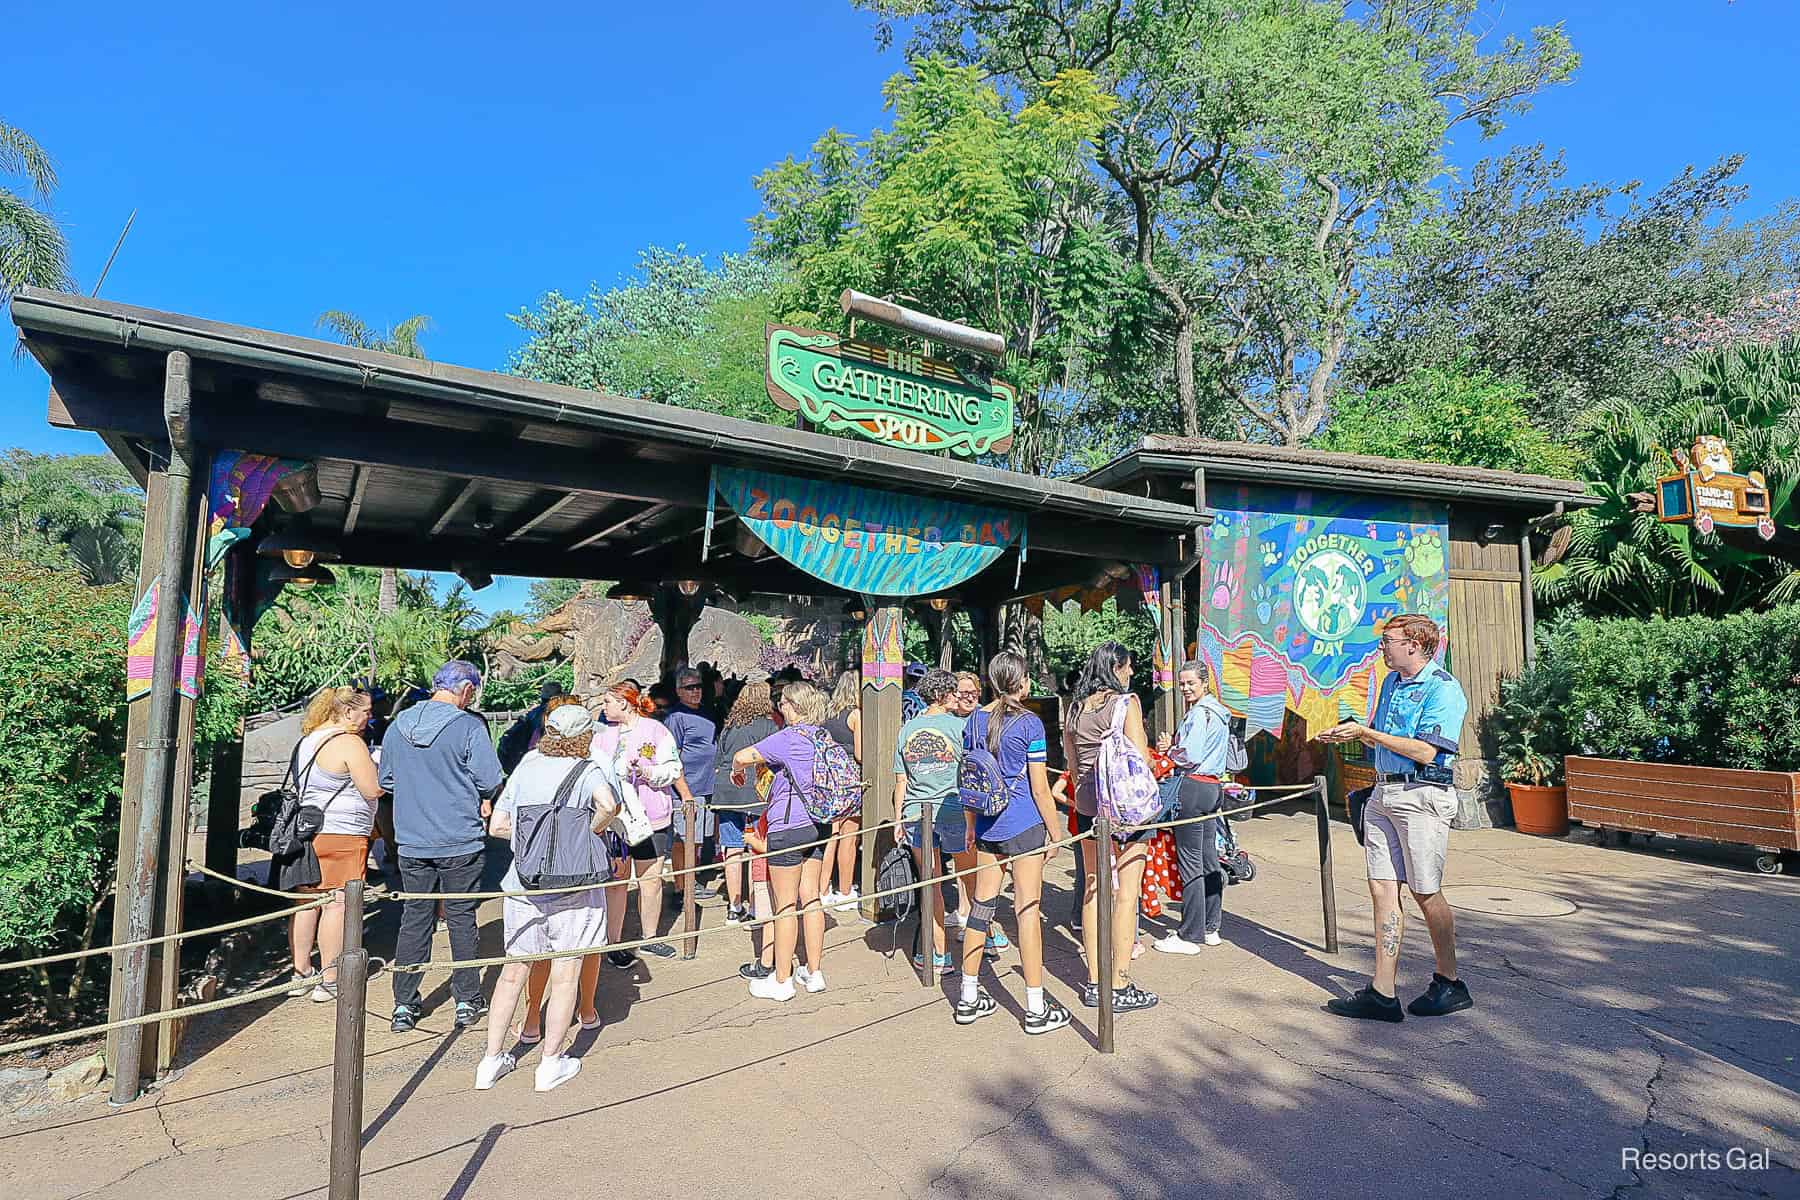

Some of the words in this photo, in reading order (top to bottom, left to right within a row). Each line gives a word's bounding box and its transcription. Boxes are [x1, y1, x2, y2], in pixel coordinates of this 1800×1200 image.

[886, 349, 924, 375] THE
[813, 360, 982, 425] GATHERING
[873, 413, 932, 447] SPOT
[747, 489, 944, 555] ZOOGETHER
[959, 519, 1011, 547] DAY
[1287, 534, 1375, 576] ZOOGETHER
[1312, 640, 1345, 656] DAY
